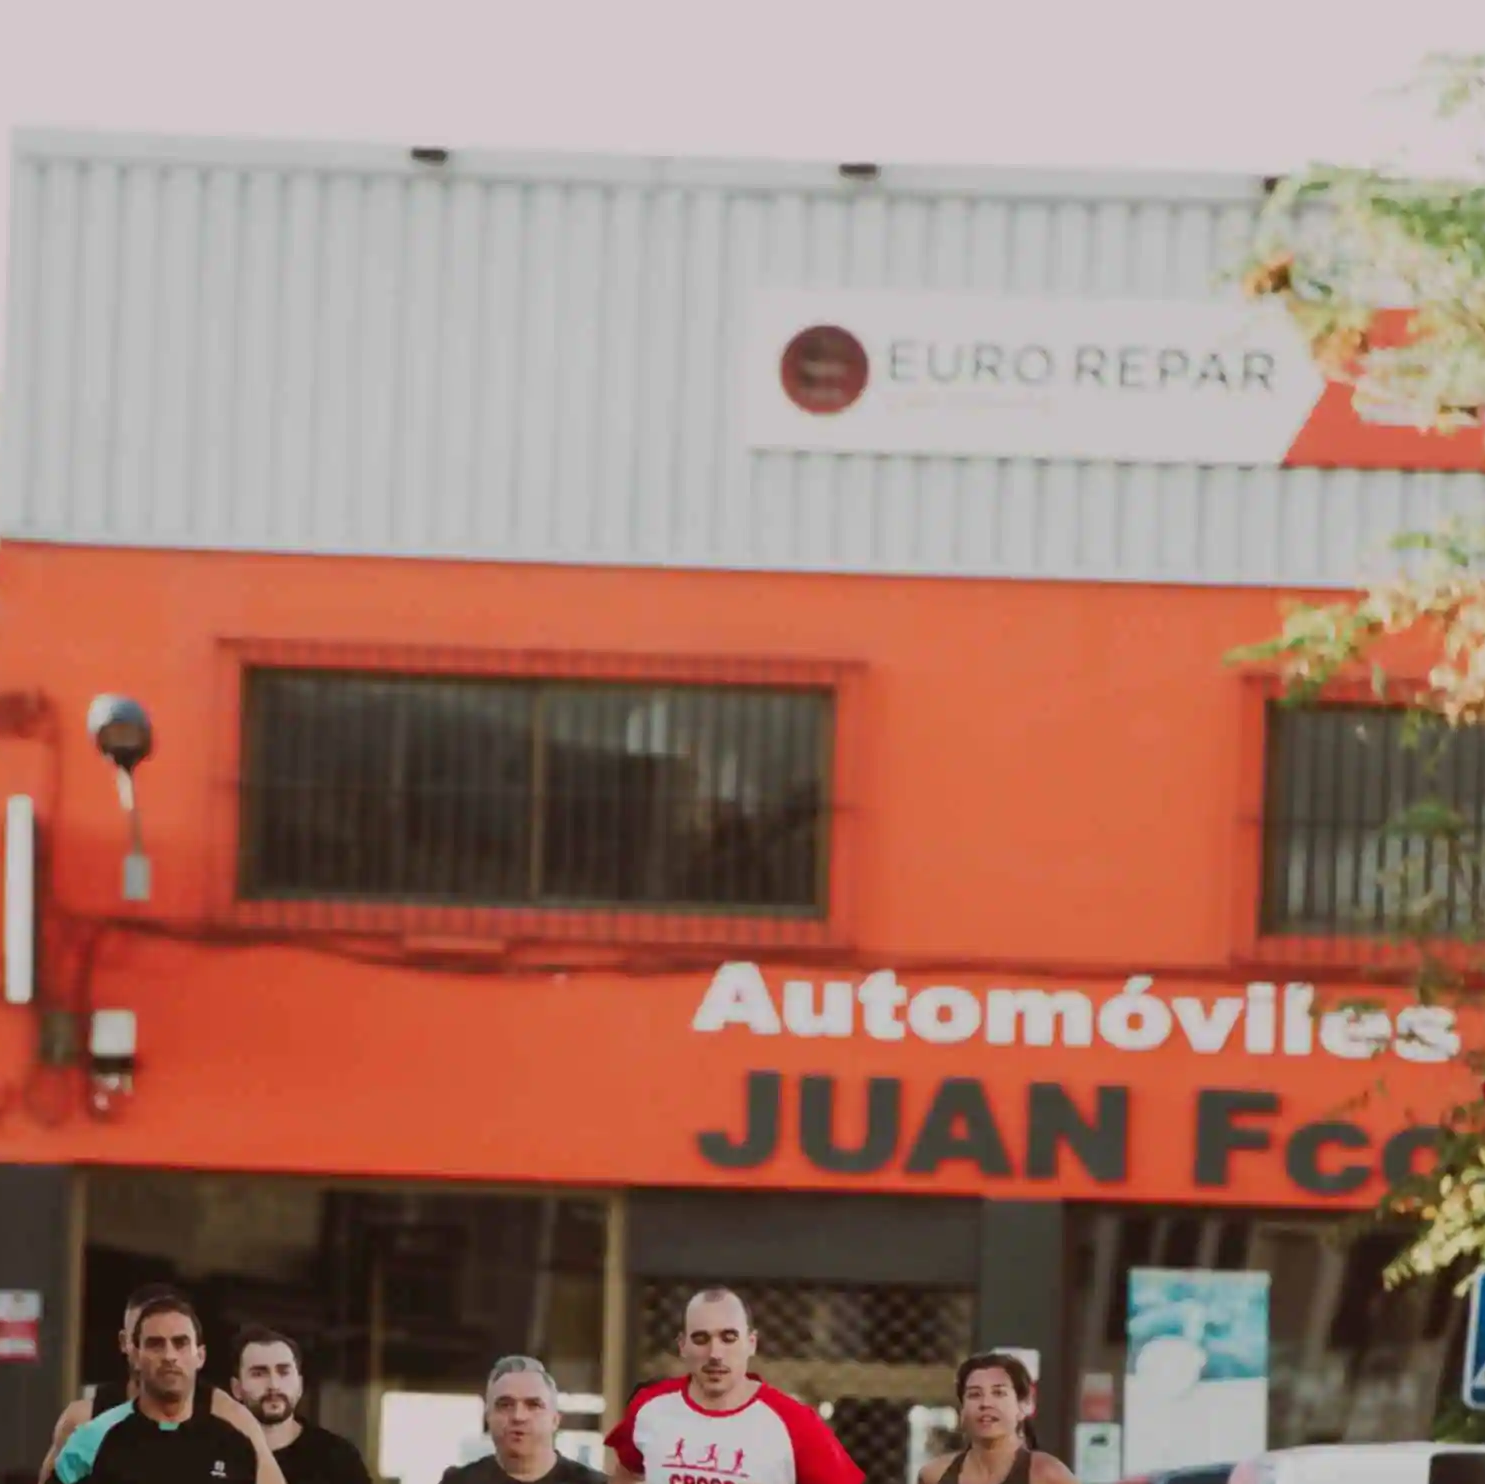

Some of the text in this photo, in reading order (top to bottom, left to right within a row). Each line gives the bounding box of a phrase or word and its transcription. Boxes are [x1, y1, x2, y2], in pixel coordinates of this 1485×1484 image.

[888, 340, 1055, 384] EURO
[1073, 344, 1278, 392] REPAR
[692, 961, 1461, 1062] Automóviles
[698, 1071, 1128, 1184] JUAN
